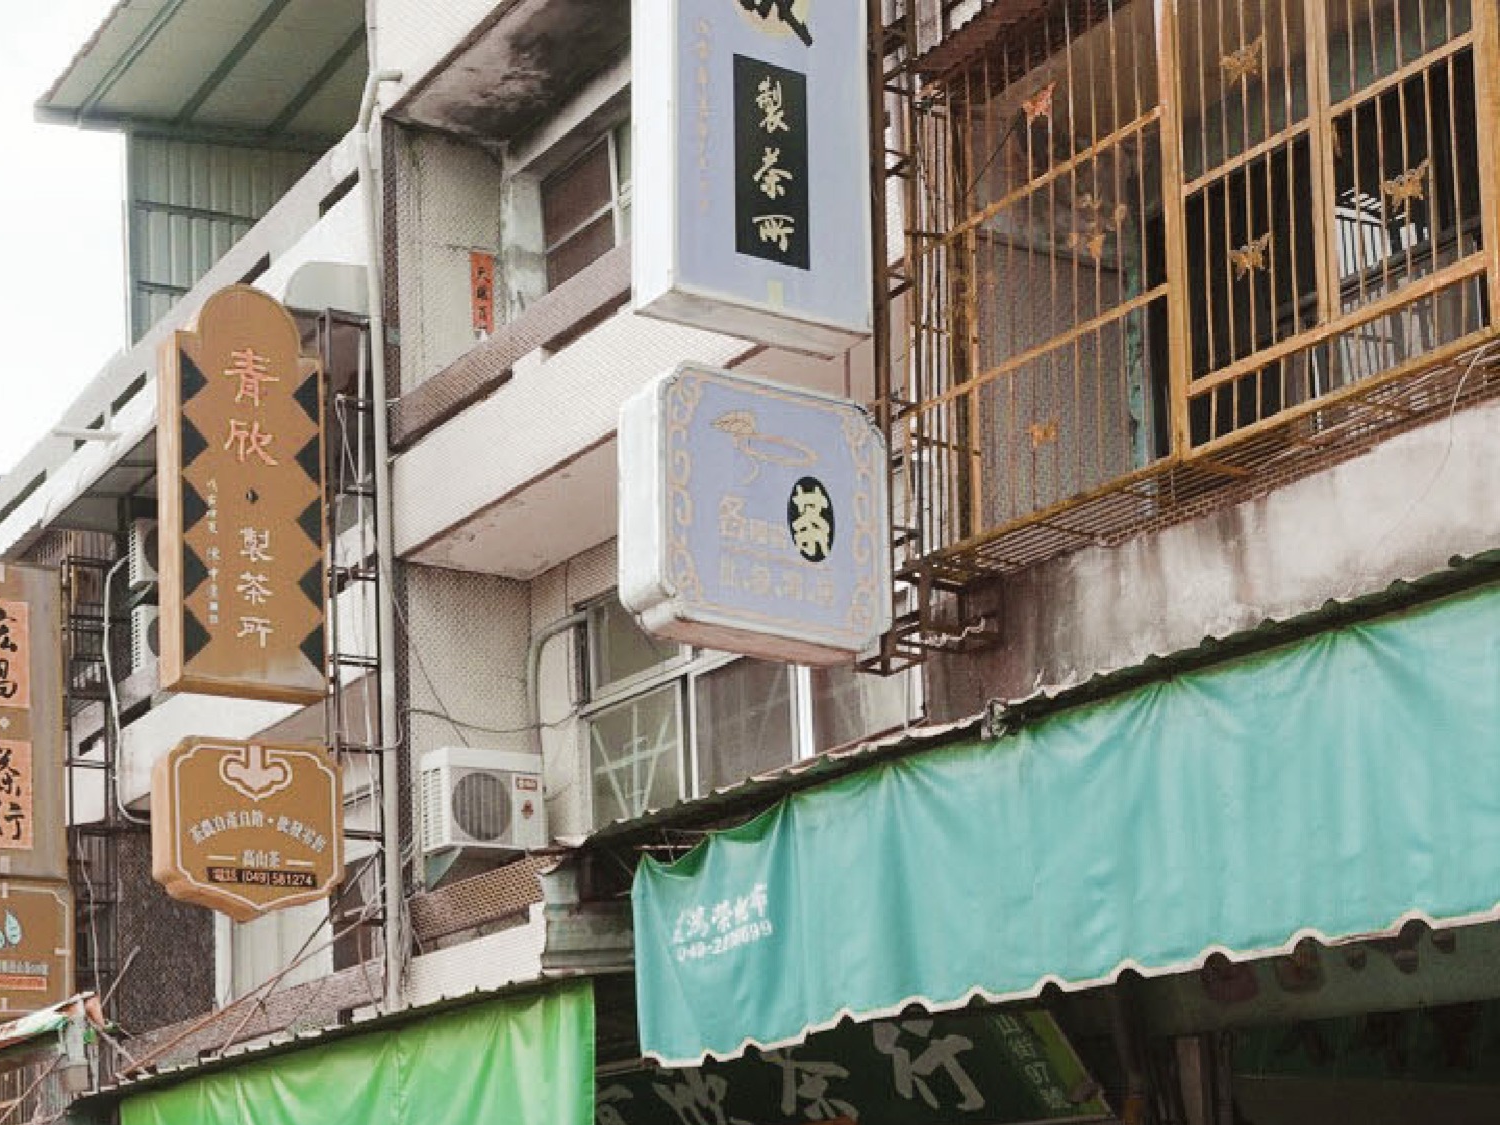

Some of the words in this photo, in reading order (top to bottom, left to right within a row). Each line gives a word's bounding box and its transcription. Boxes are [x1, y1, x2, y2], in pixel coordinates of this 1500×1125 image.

[751, 75, 794, 253] 製茶所
[223, 349, 280, 467] 青欣
[236, 526, 274, 648] 製茶所
